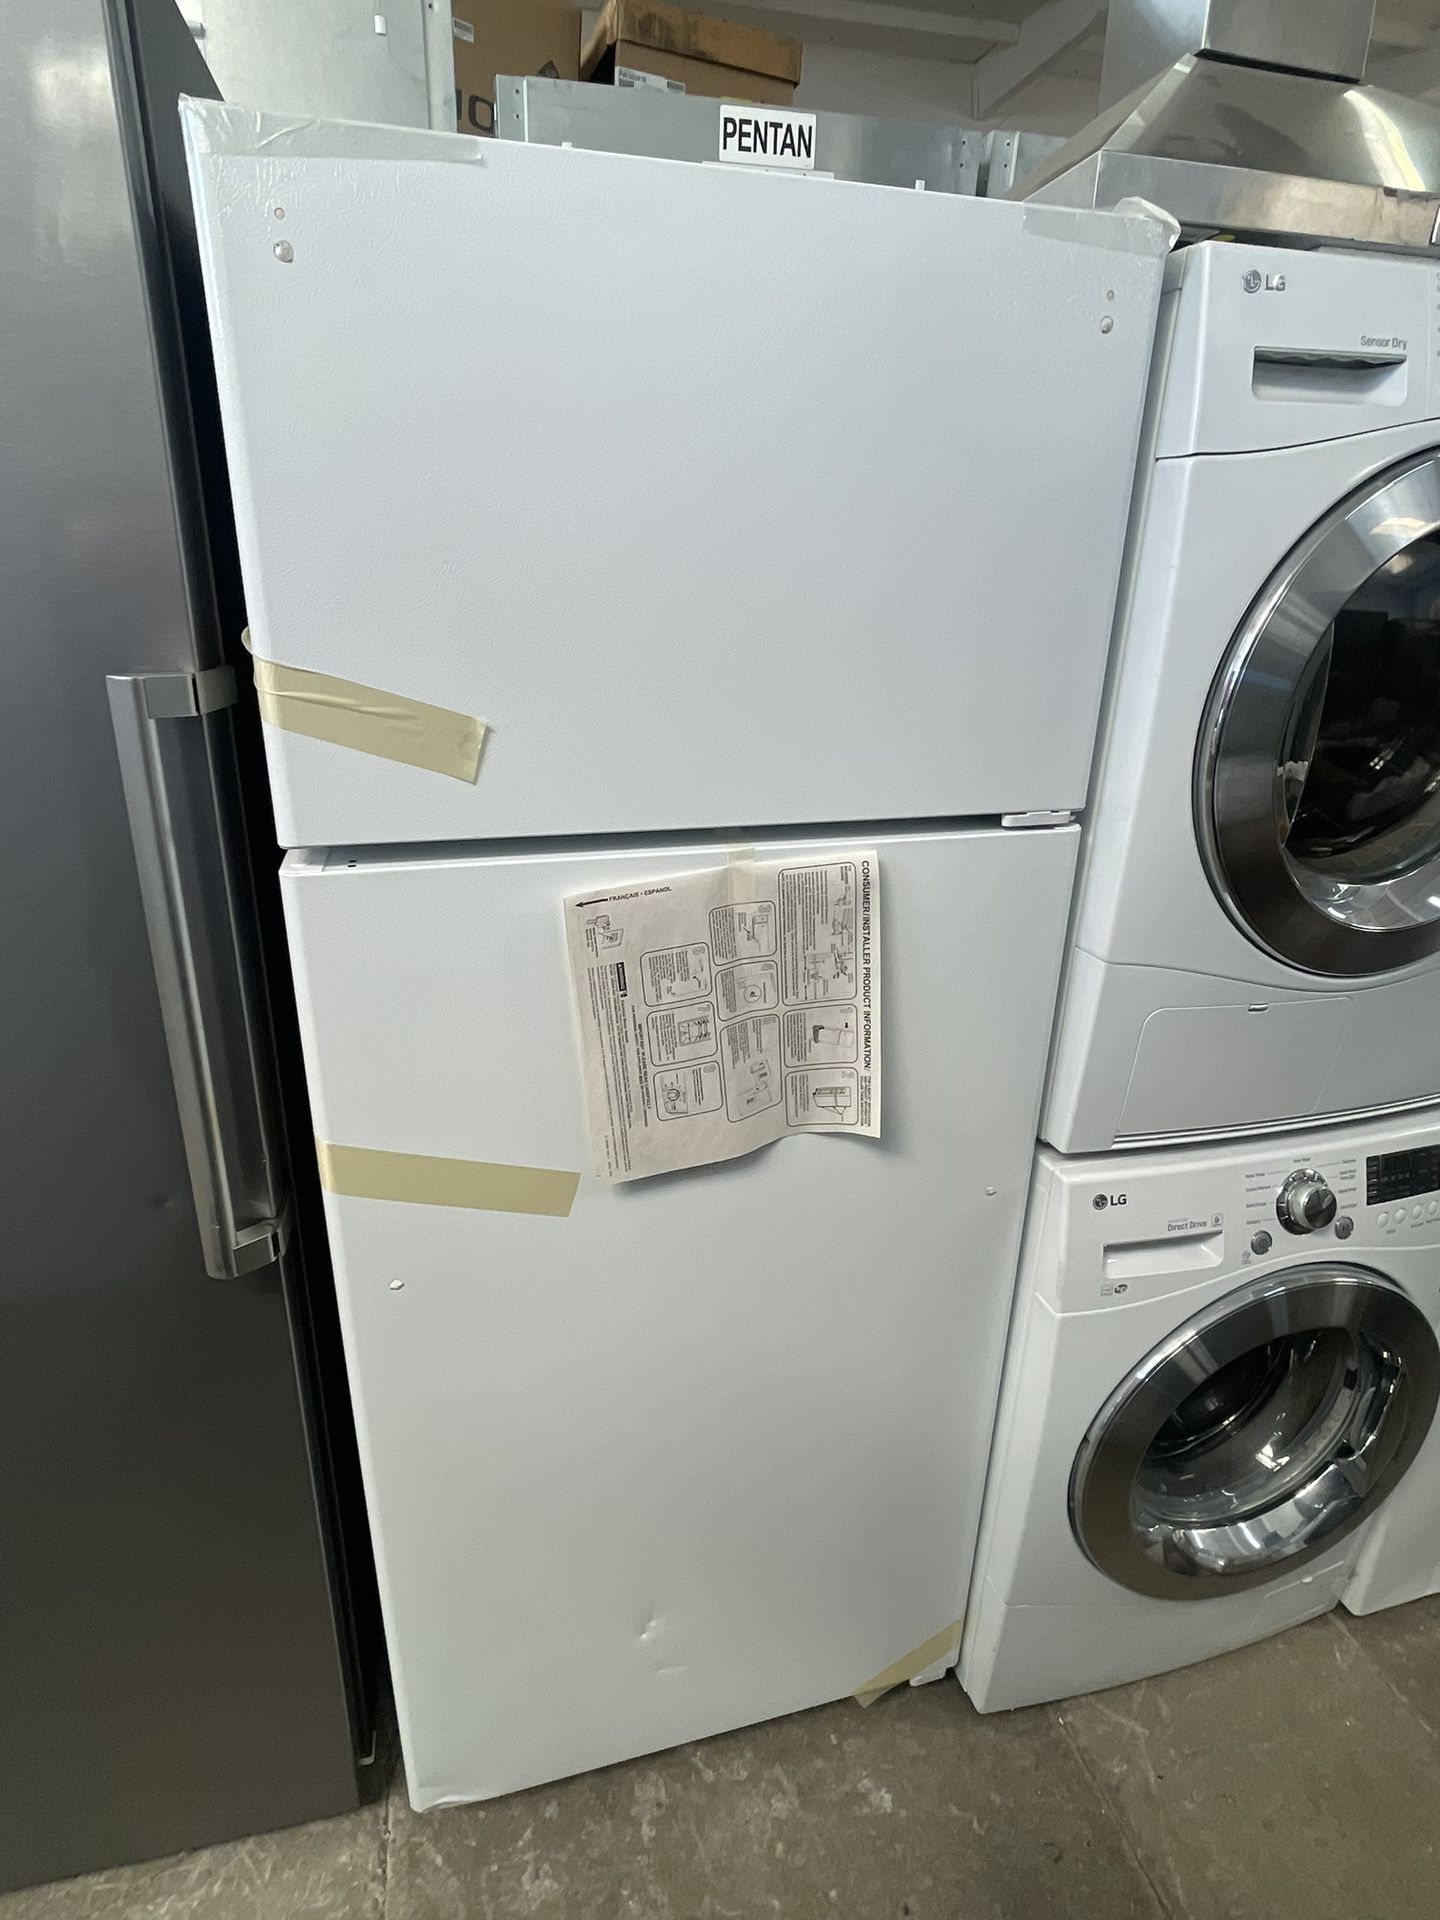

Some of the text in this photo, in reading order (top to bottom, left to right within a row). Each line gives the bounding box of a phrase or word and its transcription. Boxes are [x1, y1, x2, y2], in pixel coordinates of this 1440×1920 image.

[723, 117, 813, 158] PENTAN
[1265, 274, 1286, 291] LG
[1360, 335, 1407, 350] Sensor Dry
[861, 860, 871, 966] CONSUMER/INSTALLER
[862, 967, 872, 1009] PRODUCT
[1110, 1194, 1127, 1206] LG
[1168, 1221, 1188, 1232] Direct
[1189, 1219, 1208, 1230] Drive
